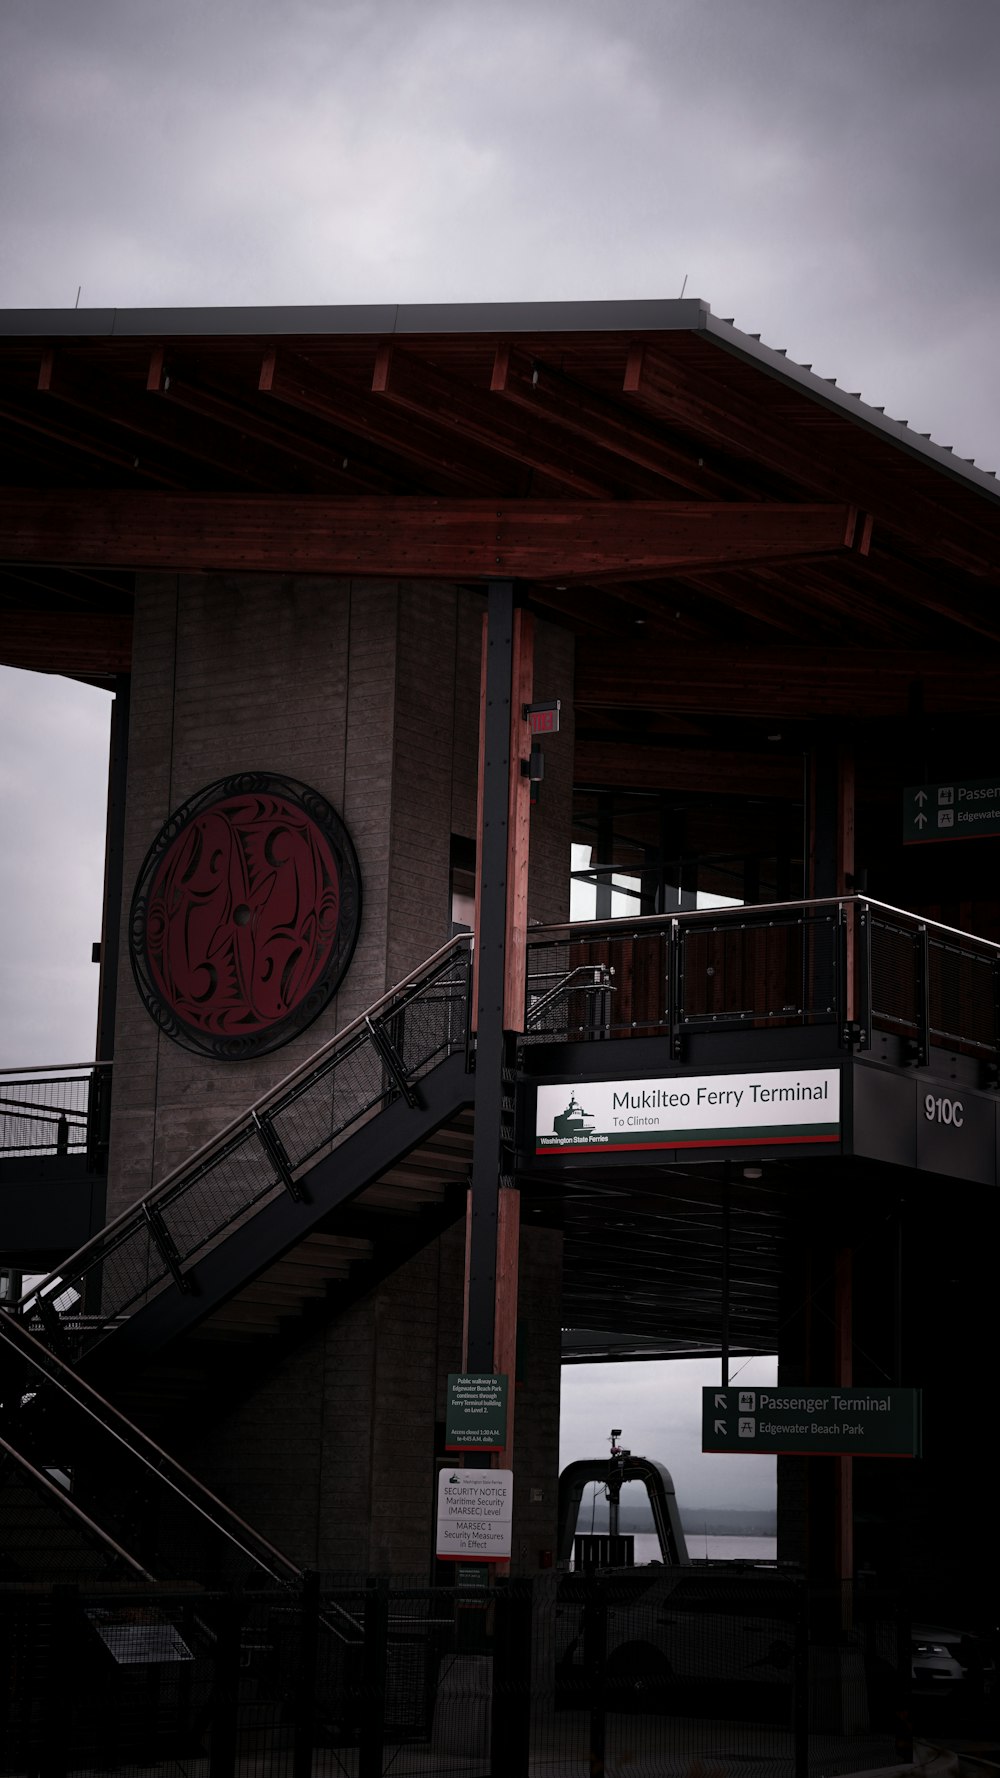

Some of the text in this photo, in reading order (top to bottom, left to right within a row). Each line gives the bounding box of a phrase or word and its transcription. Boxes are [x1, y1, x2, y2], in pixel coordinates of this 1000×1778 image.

[613, 1081, 828, 1110] Mukilteo Ferry Terminal
[925, 1094, 964, 1128] 910C
[613, 1116, 660, 1126] To Clinton
[540, 1136, 573, 1146] Washington
[760, 1394, 891, 1413] Passenger Terminal
[760, 1422, 864, 1436] Edgewater Beach Park
[444, 1488, 478, 1496] SECURITY
[446, 1498, 504, 1507] Maritime Security
[448, 1507, 482, 1516] (MARSEC)
[456, 1522, 487, 1531] MARSEC
[444, 1531, 504, 1540] Security Measures
